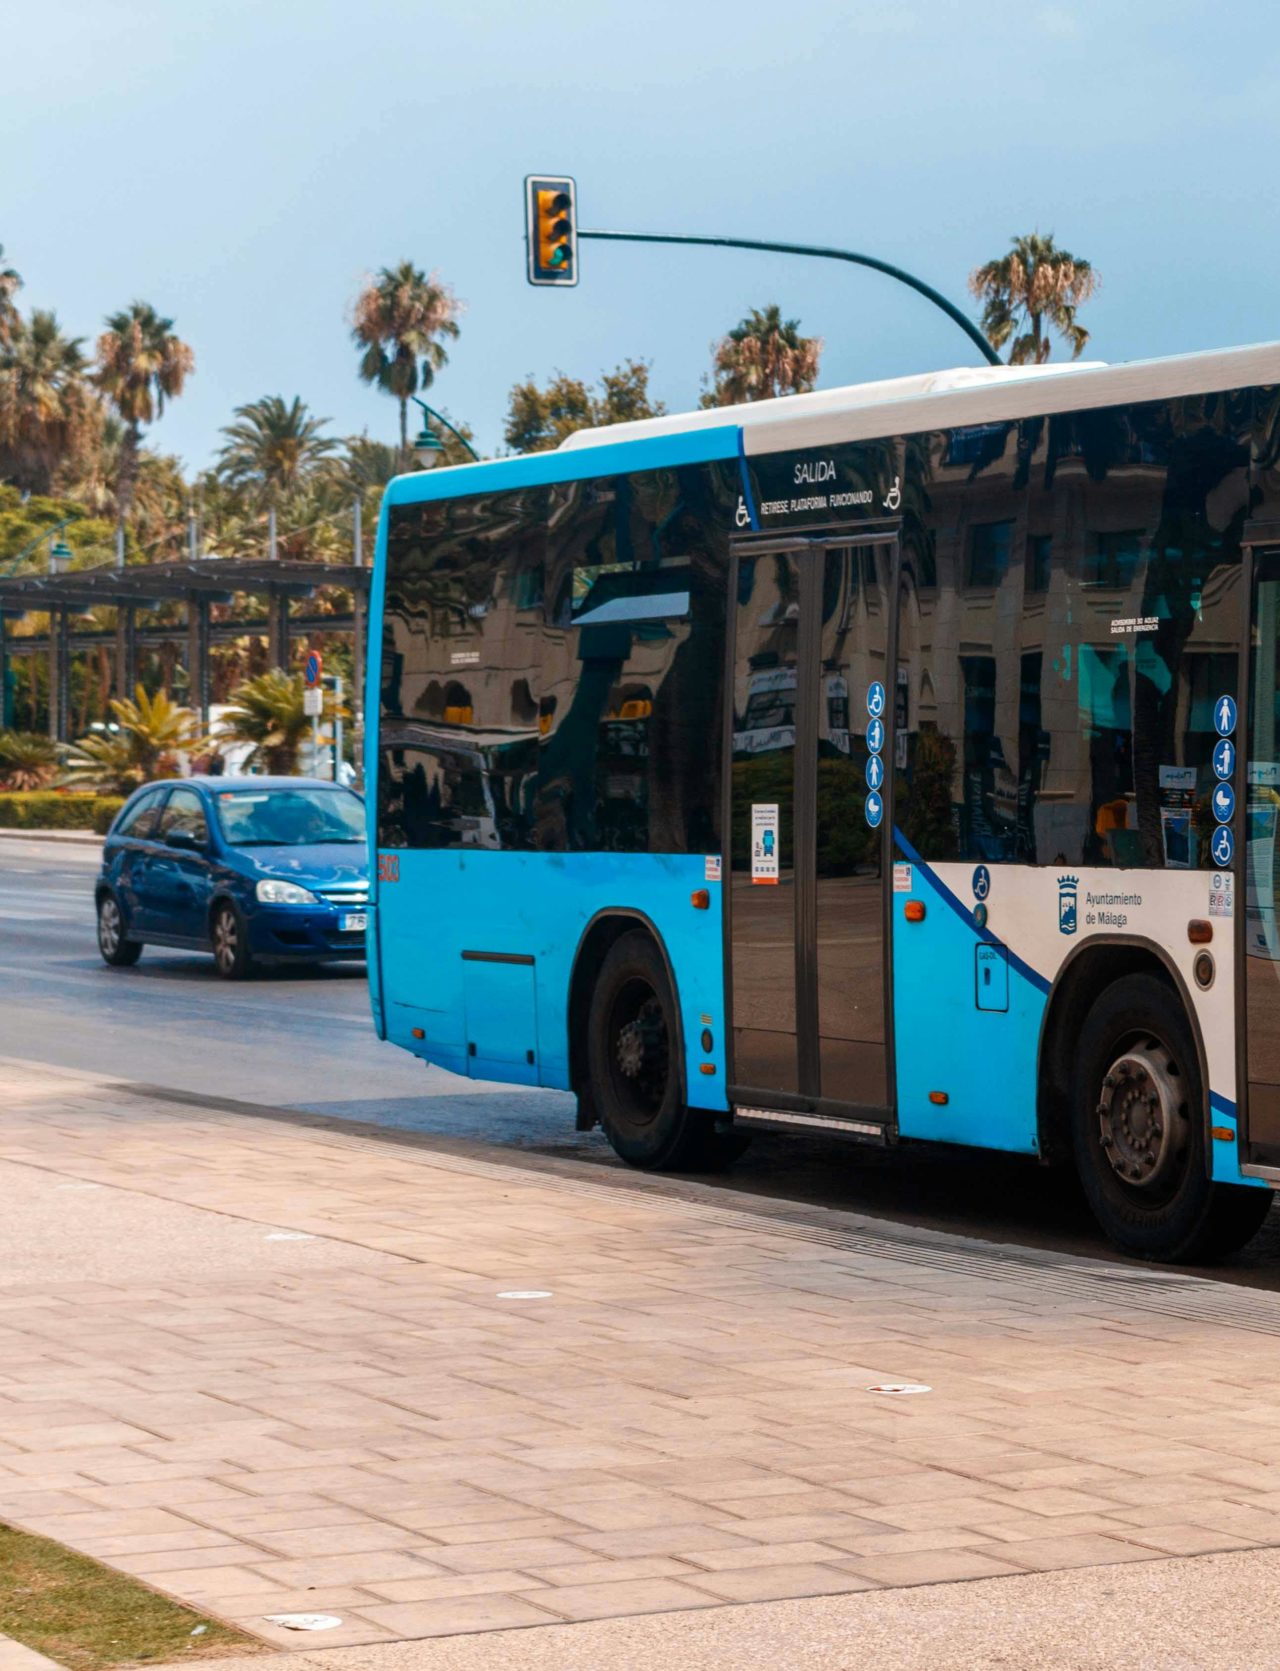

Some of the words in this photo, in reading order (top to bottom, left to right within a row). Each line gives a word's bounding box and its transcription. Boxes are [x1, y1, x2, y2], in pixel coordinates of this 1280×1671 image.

[794, 461, 836, 484] SALIDA
[790, 497, 827, 512] PLATAFORMA
[829, 490, 873, 507] FUNCIONANDO
[1086, 892, 1142, 909] Ayuntamiento
[1086, 912, 1096, 925] de
[1097, 911, 1128, 928] Málaga
